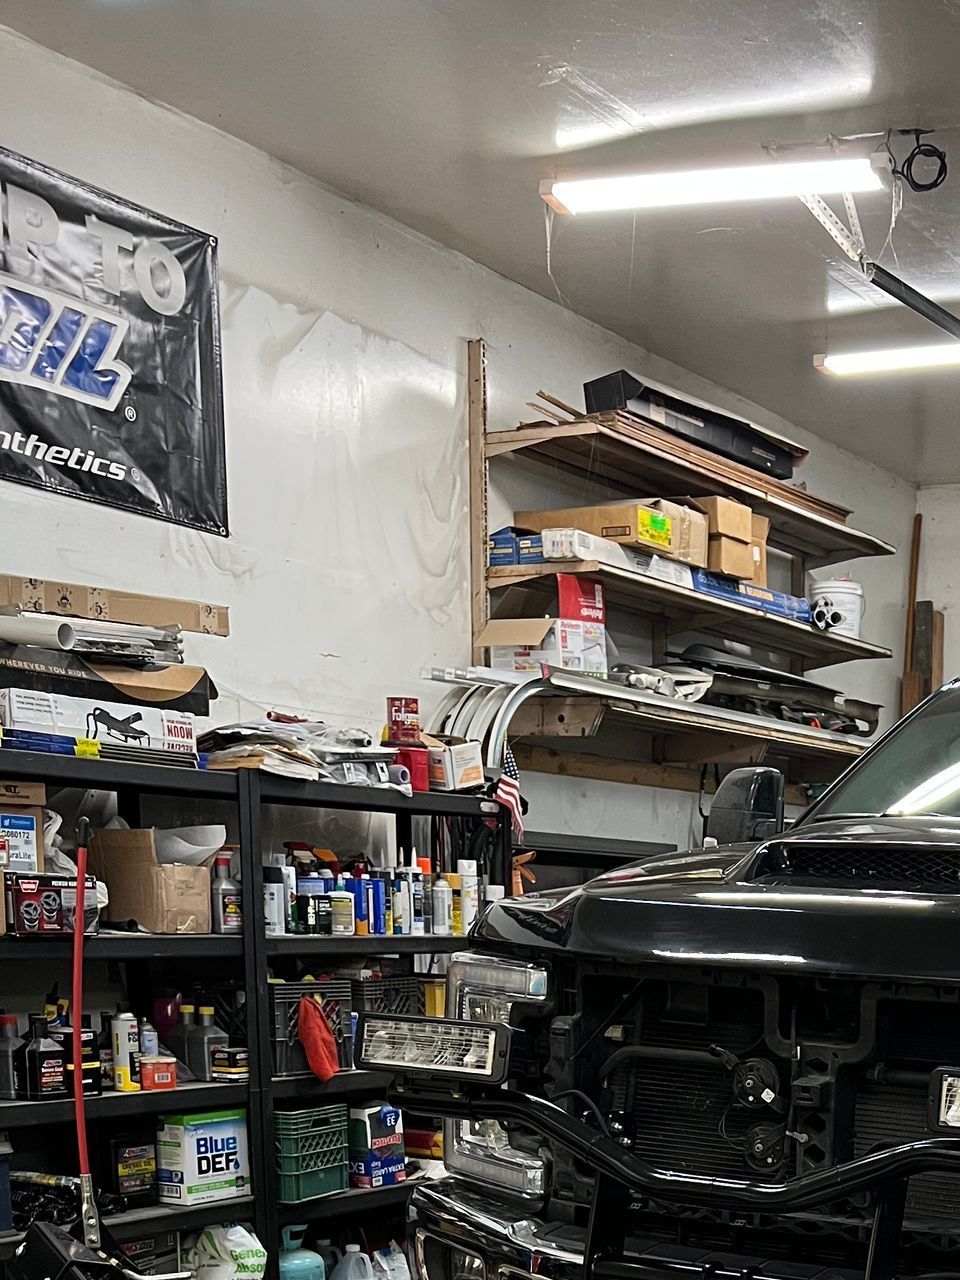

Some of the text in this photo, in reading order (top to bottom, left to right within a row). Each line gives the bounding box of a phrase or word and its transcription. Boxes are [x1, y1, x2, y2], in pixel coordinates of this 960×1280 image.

[84, 213, 187, 316] TO
[0, 658, 47, 671] WHEREVER
[48, 665, 66, 675] YOU
[162, 723, 193, 740] MOUN
[386, 1116, 396, 1127] 33
[195, 1136, 237, 1156] Blue
[196, 1151, 239, 1176] DEF
[234, 1262, 265, 1274] Abso
